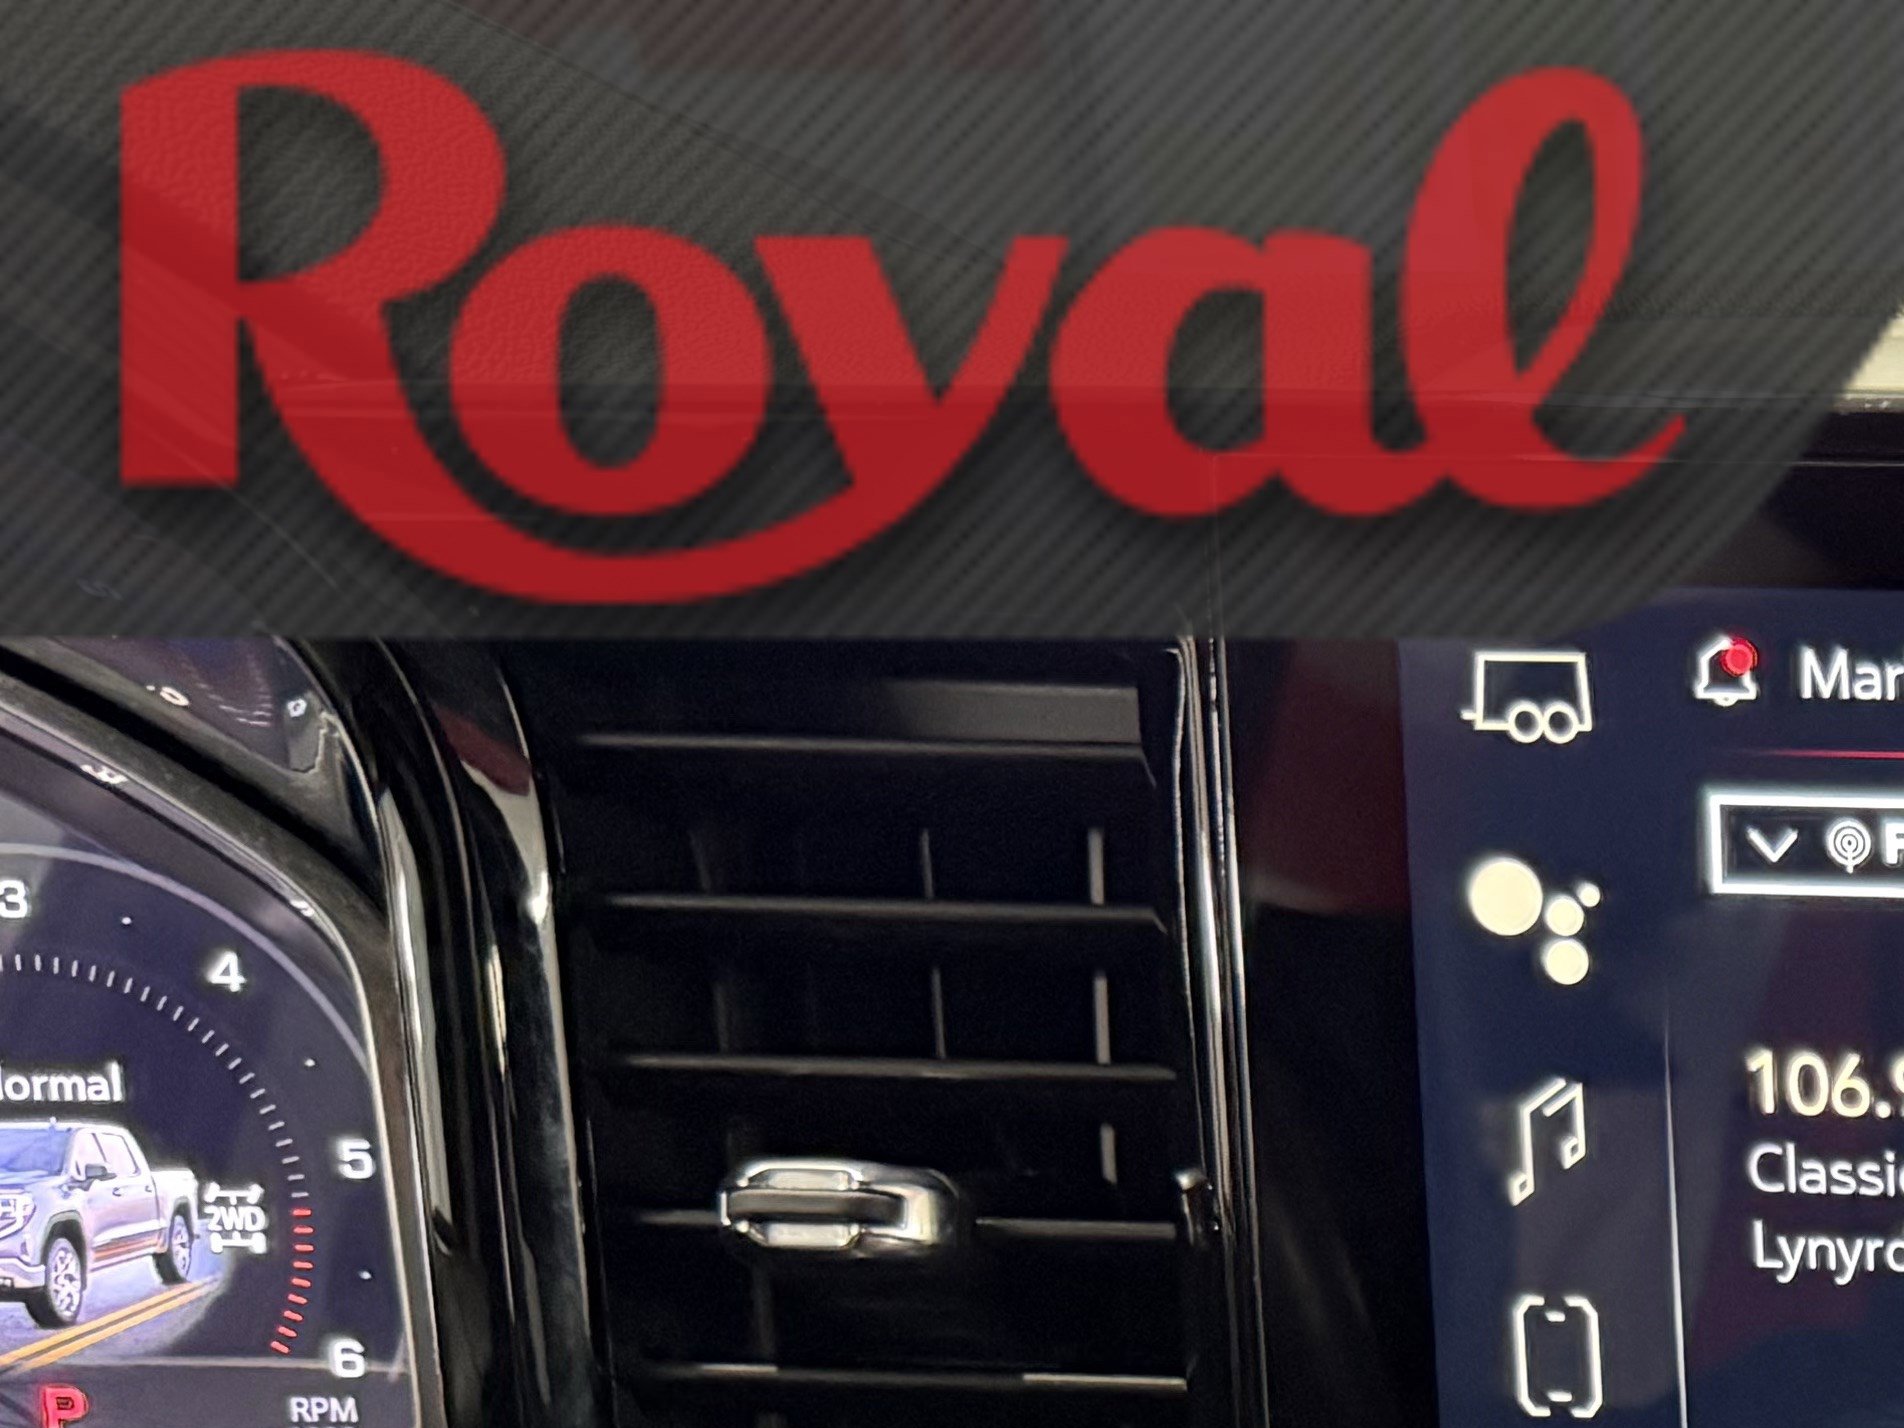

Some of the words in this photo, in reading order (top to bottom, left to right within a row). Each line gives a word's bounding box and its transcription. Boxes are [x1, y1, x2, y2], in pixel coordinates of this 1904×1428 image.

[0, 878, 31, 918] 3
[208, 951, 245, 992] 4
[0, 1061, 124, 1104] ormal
[339, 1138, 374, 1178] 5
[206, 1206, 266, 1231] 2WD
[331, 1338, 366, 1378] 6
[289, 1397, 358, 1422] RPM
